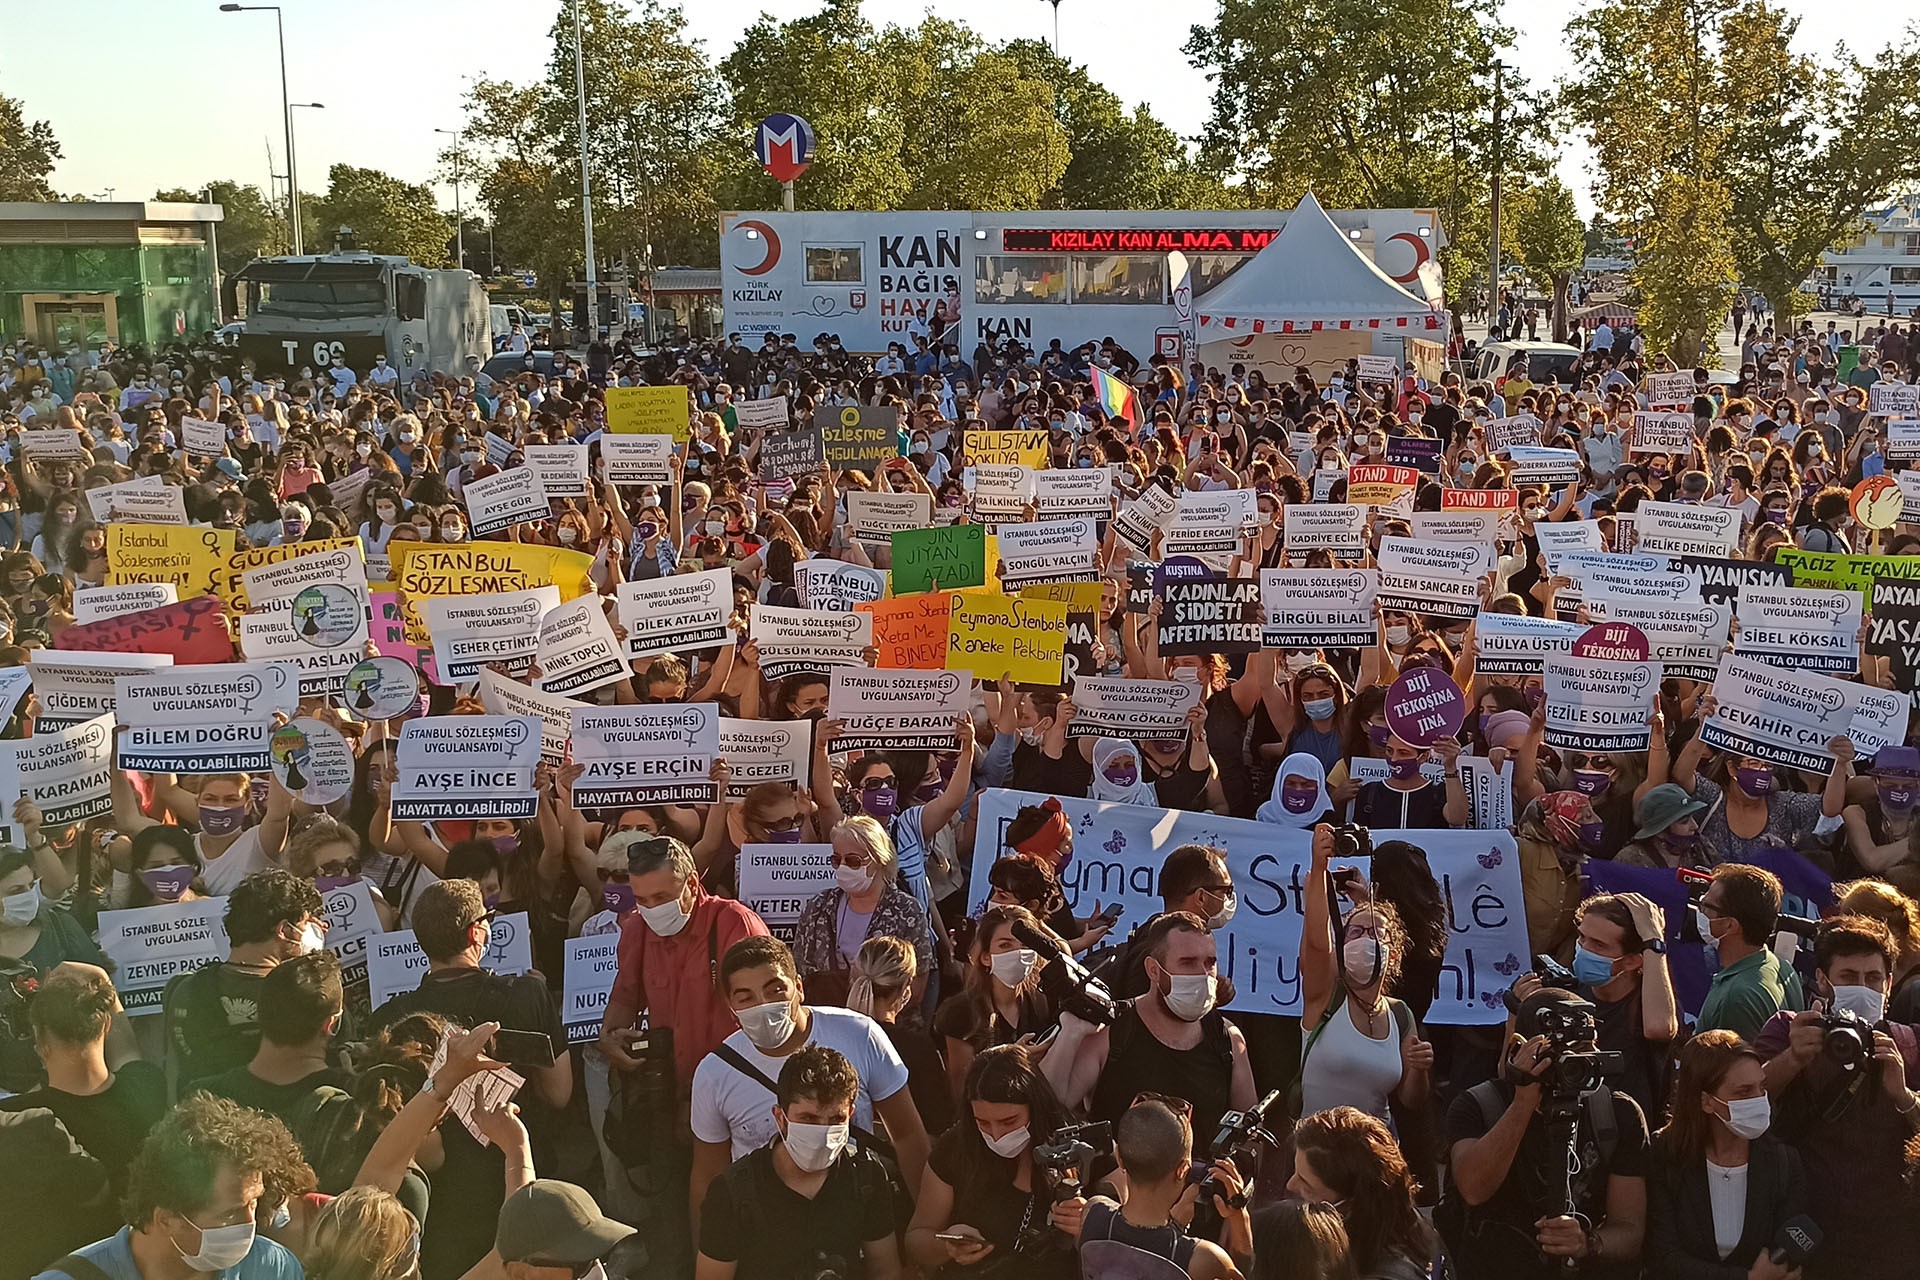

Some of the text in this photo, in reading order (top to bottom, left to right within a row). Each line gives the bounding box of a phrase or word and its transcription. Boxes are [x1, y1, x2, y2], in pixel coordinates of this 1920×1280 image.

[1052, 233, 1113, 247] KIZILAY
[1119, 233, 1152, 247] KAN
[1157, 232, 1233, 247] ALMA
[879, 236, 960, 268] KAN
[747, 281, 769, 289] TÜRK
[733, 290, 782, 301] KIZILAY
[978, 318, 1031, 338] KAN
[282, 341, 298, 365] T
[1656, 391, 1693, 400] UYGULA
[1879, 403, 1915, 412] UYGULA
[1645, 419, 1689, 430] İSTANBUL
[1498, 436, 1536, 448] UYGULA
[1644, 436, 1688, 447] UYGULA
[633, 461, 663, 469] YILDIRIM
[1549, 461, 1575, 470] KUZDAN
[551, 471, 578, 480] DEMİRİN
[1353, 467, 1409, 482] STAND UP
[484, 495, 532, 516] AYŞE GÜR
[1041, 497, 1106, 506] FİLİZ KAPLAN
[1448, 492, 1509, 507] STAND UP
[1128, 508, 1155, 532] TEKİNAY
[1644, 510, 1679, 519] İSTANBUL
[860, 521, 918, 530] TUĞÇE TATAR
[119, 528, 168, 547] İstanbul
[929, 530, 952, 545] JIN
[1004, 529, 1038, 539] İSTANBUL
[1171, 529, 1232, 538] FERİDE ERCAN
[1291, 532, 1359, 543] KADRİYE ECİM
[1643, 538, 1727, 556] MELİKE DEMİRCİ
[412, 551, 521, 571] İSTANBUL
[1009, 554, 1088, 570] SONGÜL YALÇIN
[1781, 554, 1837, 572] TACİZ
[1165, 565, 1203, 578] KUŞTINA
[1268, 577, 1361, 588] İSTANBUL SÖZLEŞMESİ
[1384, 574, 1475, 595] ÖZLEM SANCAR ER
[1845, 581, 1858, 591] VE
[633, 590, 667, 601] İSTANBUL
[1165, 584, 1259, 603] KADINLAR
[1286, 589, 1347, 599] UYGULANSAYDI
[648, 595, 701, 609] UYGULANSAYDI
[447, 608, 486, 619] İSTANBUL
[952, 595, 1065, 632] Peymana Stenbolê
[1175, 603, 1242, 623] ŞİDDETİ
[1272, 609, 1366, 624] BİRGÜL BİLAL
[1615, 608, 1657, 619] İSTANBUL
[1763, 608, 1829, 620] UYGULANSAYDI
[637, 611, 719, 632] DİLEK ATALAY
[776, 627, 841, 639] UYGULANSAYDI
[1266, 633, 1371, 645] HAYATTA OLABİLİRDİ!
[1744, 629, 1847, 648] SİBEL KÖKSAL
[453, 639, 490, 655] SEHER
[634, 637, 671, 650] HAYATTA
[758, 645, 862, 657] GÜLSÜM KARASU
[1484, 637, 1528, 650] HÜLYA
[1657, 643, 1713, 659] ÇETİNEL
[308, 652, 361, 668] ASLAN
[545, 643, 608, 673] MİNE TOPÇU
[1480, 661, 1523, 671] HAYATTA
[840, 676, 953, 690] İSTANBUL SÖZLEŞMESİ
[1405, 670, 1431, 693] BİJÎ
[128, 681, 254, 698] İSTANBUL SÖZLEŞMESİ
[861, 690, 936, 702] UYGULANSAYDI
[47, 693, 97, 711] ÇİĞDEM
[152, 697, 236, 711] UYGULANSAYDI
[1394, 688, 1456, 718] TÊKOŞİNA
[581, 713, 699, 730] İSTANBUL SÖZLEŞMESİ
[1079, 708, 1182, 725] NURAN GÖKALP
[1547, 705, 1645, 725] FEZİLE SOLMAZ
[841, 715, 953, 732] TUĞÇE BARAN
[1417, 713, 1446, 736] JİNA
[1718, 703, 1793, 738] CEVAHİR
[1796, 729, 1831, 748] ÇAY
[132, 720, 262, 746] BİLEM DOĞRU
[406, 724, 521, 741] İSTANBUL SÖZLEŞMESİ
[603, 730, 682, 743] UYGULANSAYDI
[425, 742, 503, 755] UYGULANSAYDI
[832, 738, 882, 751] HAYATTA
[125, 753, 270, 770] HAYATTA OLABİLİRDİ!
[588, 757, 703, 779] AYŞE ERÇİN
[747, 764, 789, 776] GEZER
[415, 769, 517, 792] AYŞE İNCE
[578, 786, 711, 804] HAYATTA OLABİLİRDİ!
[397, 800, 529, 816] HAYATTA OLABİLİRDİ!
[751, 856, 798, 866] İSTANBUL
[751, 900, 801, 913] YETER
[127, 961, 177, 980] ZEYNEP
